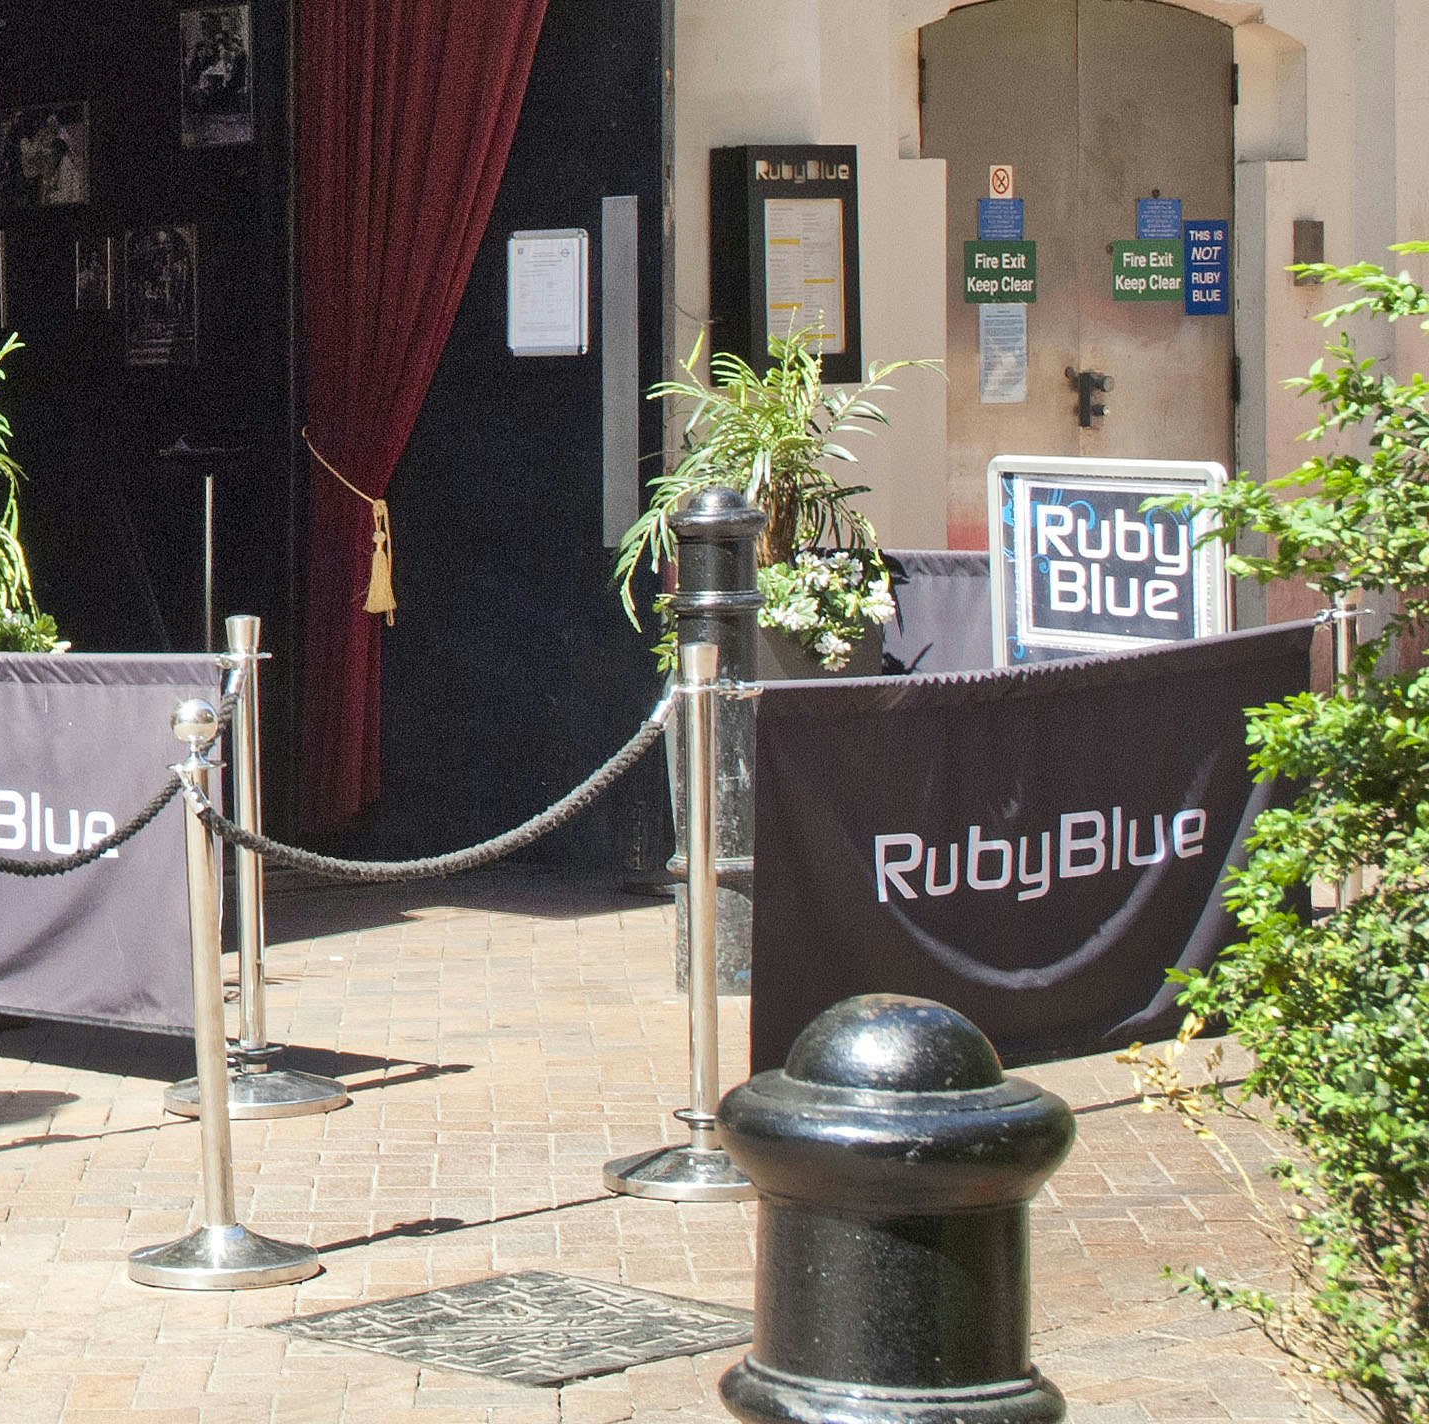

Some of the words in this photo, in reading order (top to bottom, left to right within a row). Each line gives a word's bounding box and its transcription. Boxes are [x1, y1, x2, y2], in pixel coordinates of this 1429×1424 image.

[755, 160, 850, 184] RubyBlue
[1189, 230, 1211, 241] THIS
[1214, 230, 1223, 241] IS
[975, 253, 999, 269] Fire
[1002, 253, 1026, 269] Exit
[1123, 251, 1146, 267] Fire
[1149, 251, 1174, 268] Exit
[1191, 246, 1221, 261] NOT
[967, 276, 999, 296] Keep
[1001, 276, 1034, 292] Clear
[1115, 274, 1146, 293] Keep
[1149, 274, 1182, 290] Clear
[1191, 272, 1221, 284] RUBY
[1192, 290, 1221, 302] BLUE
[1036, 504, 1189, 576] Ruby
[1049, 560, 1180, 620] Blue
[874, 806, 1207, 902] RubyBlue
